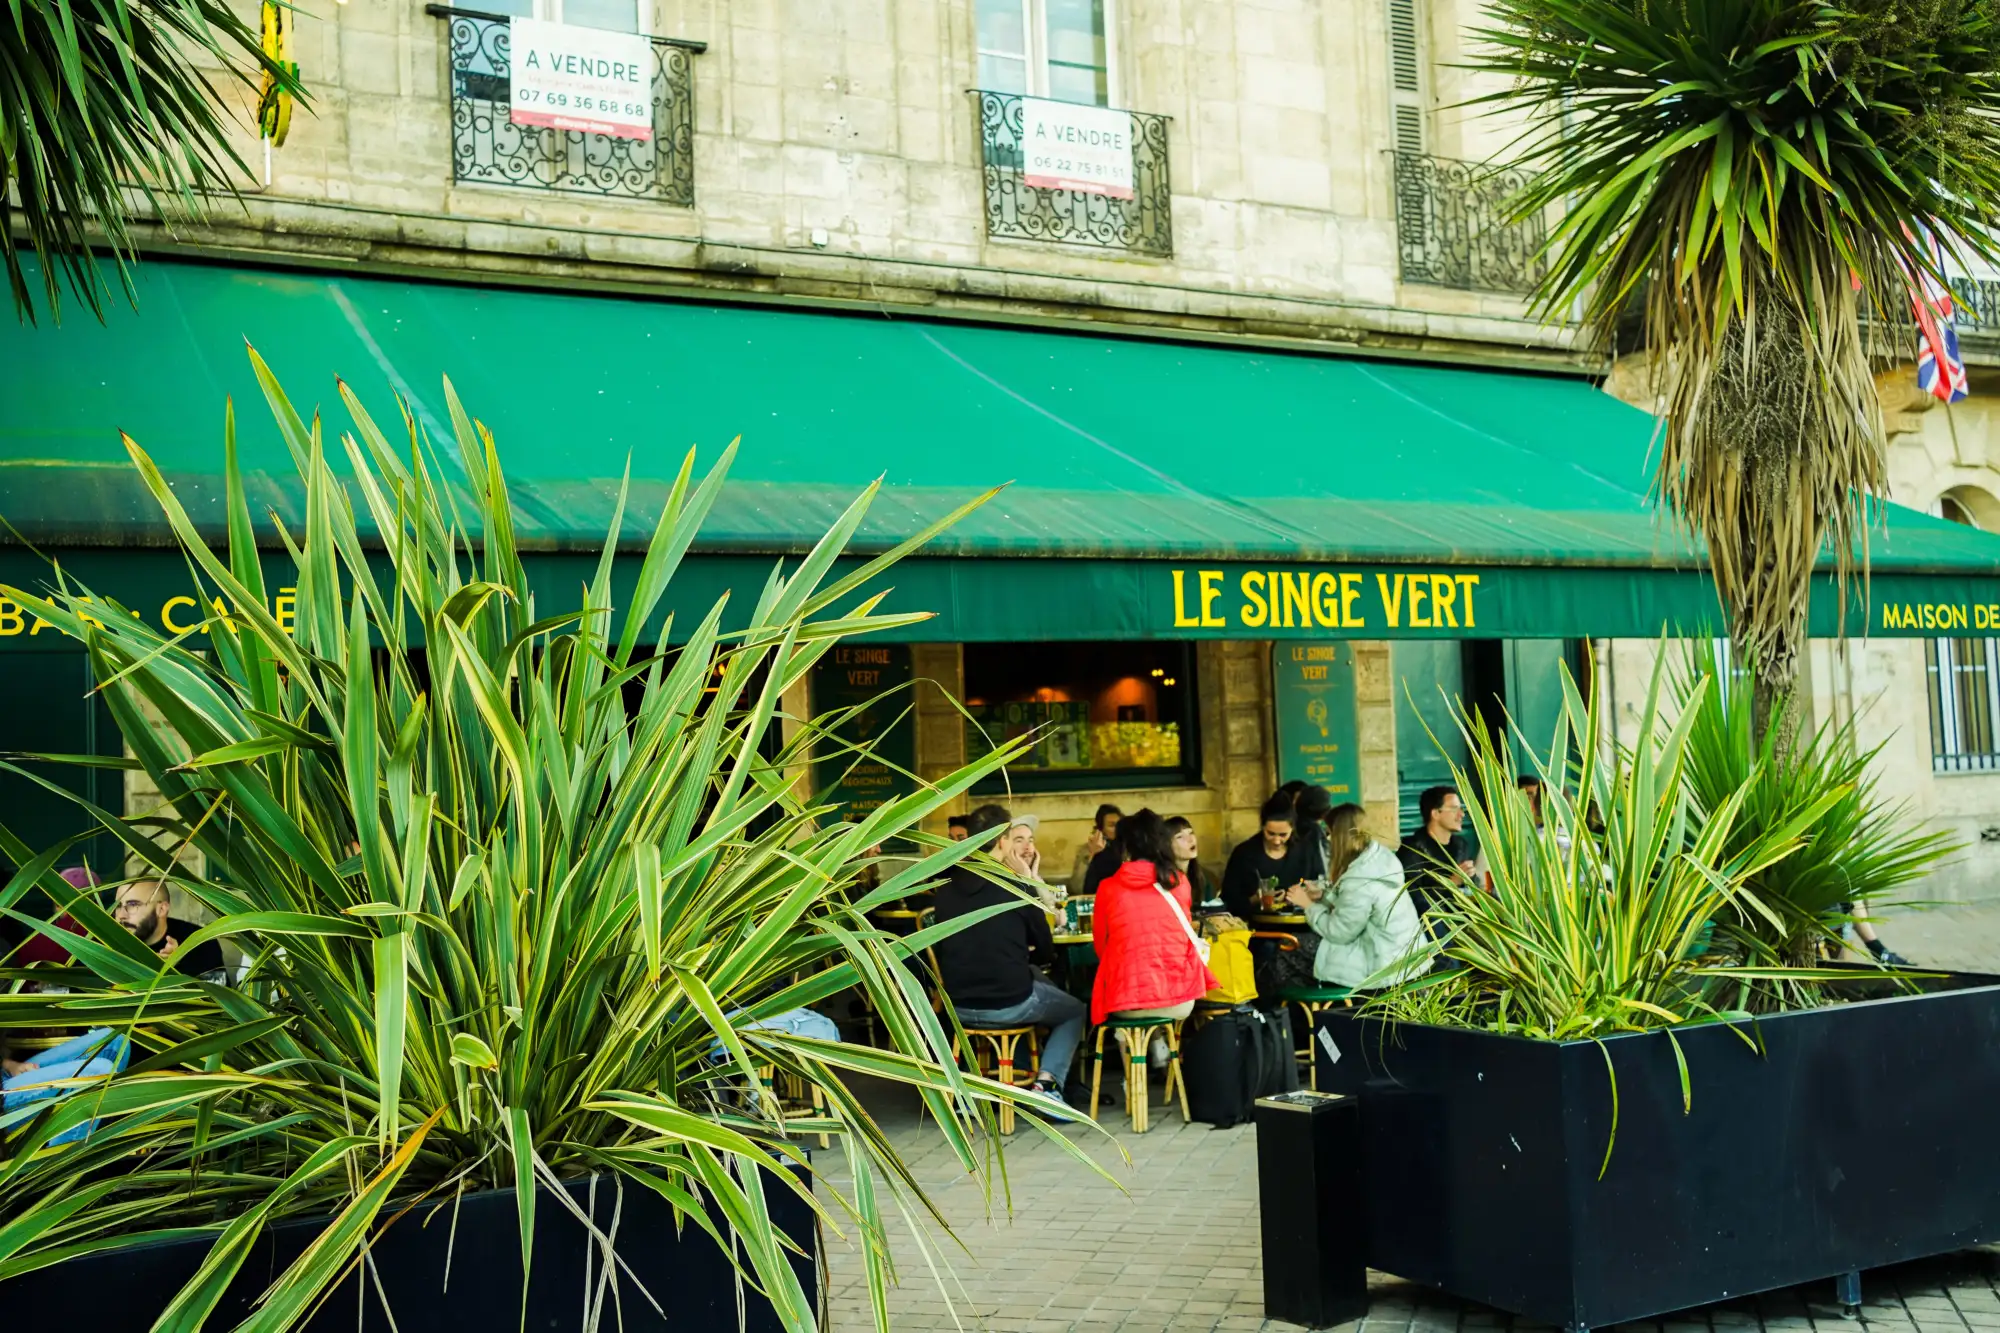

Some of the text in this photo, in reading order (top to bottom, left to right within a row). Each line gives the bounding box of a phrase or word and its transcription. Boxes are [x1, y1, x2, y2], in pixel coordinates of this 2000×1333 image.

[526, 49, 640, 83] A VENDRE
[519, 89, 645, 116] 07 69 36 68 68
[1036, 123, 1123, 150] A VENDRE
[1034, 156, 1052, 168] 06
[1057, 159, 1072, 171] 22
[1077, 161, 1091, 174] 75
[1172, 570, 1480, 627] LE SINGE VERT
[1883, 603, 2000, 629] MAISON DE
[835, 649, 891, 664] LE SINGE
[1292, 647, 1336, 661] LE SINGE
[847, 670, 881, 685] VERT
[1302, 665, 1327, 680] VERT
